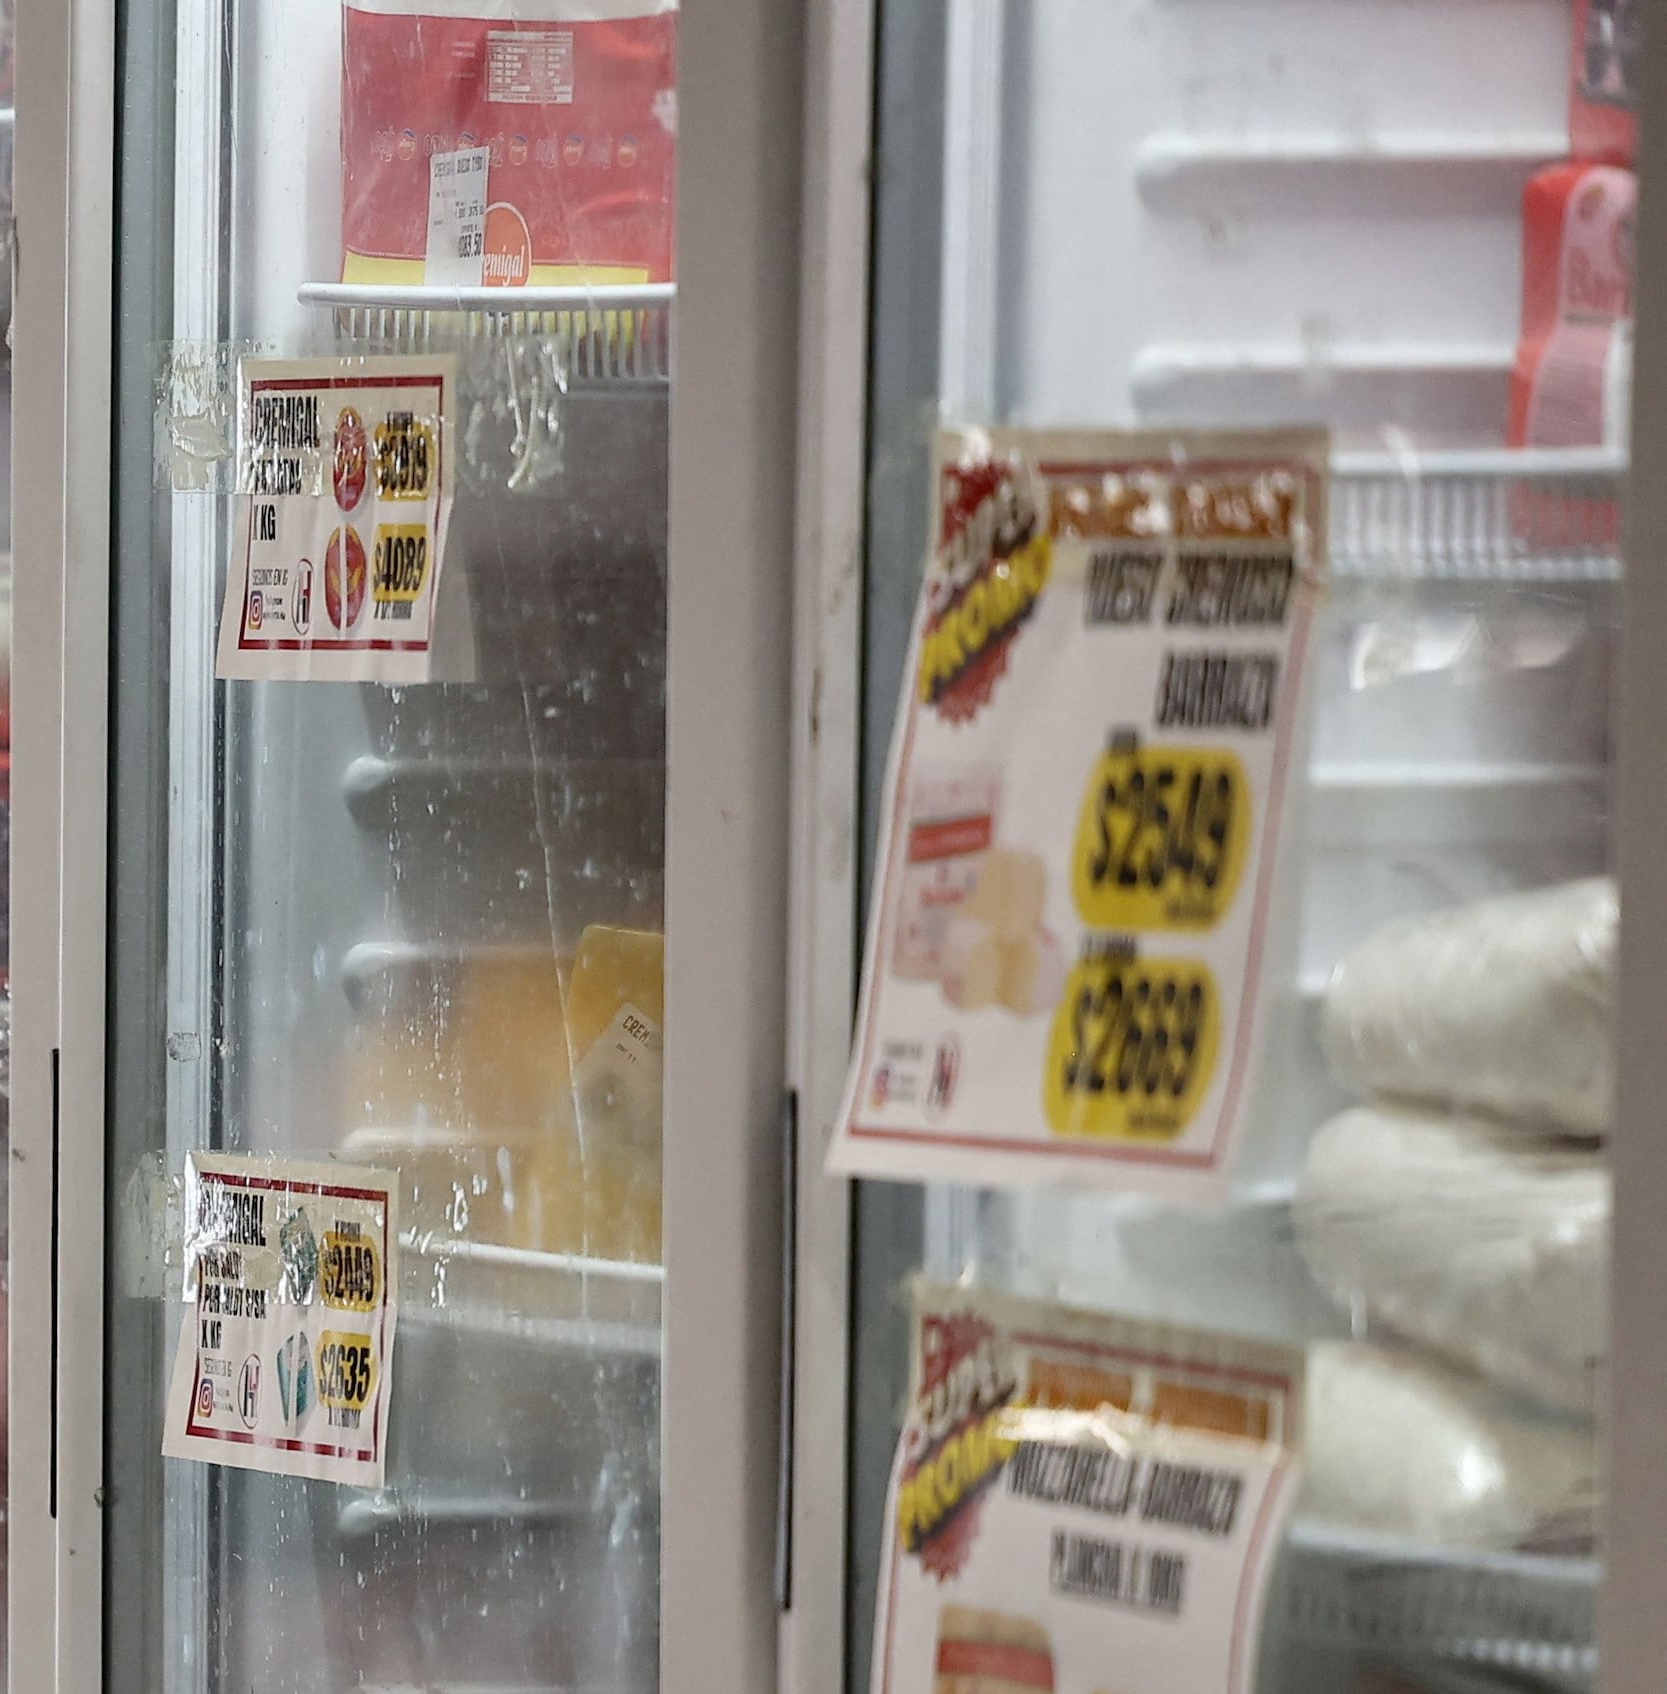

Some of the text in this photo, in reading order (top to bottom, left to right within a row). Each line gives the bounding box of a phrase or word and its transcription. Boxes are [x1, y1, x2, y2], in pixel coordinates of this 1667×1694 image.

[484, 245, 525, 286] emigal
[254, 396, 320, 448] CREMIGAL
[260, 504, 276, 540] KG
[373, 536, 427, 593] $4089
[1090, 765, 1235, 894] $2549
[204, 1190, 266, 1246] MIGAL
[202, 1319, 222, 1350] X KG
[320, 1344, 371, 1402] $2635
